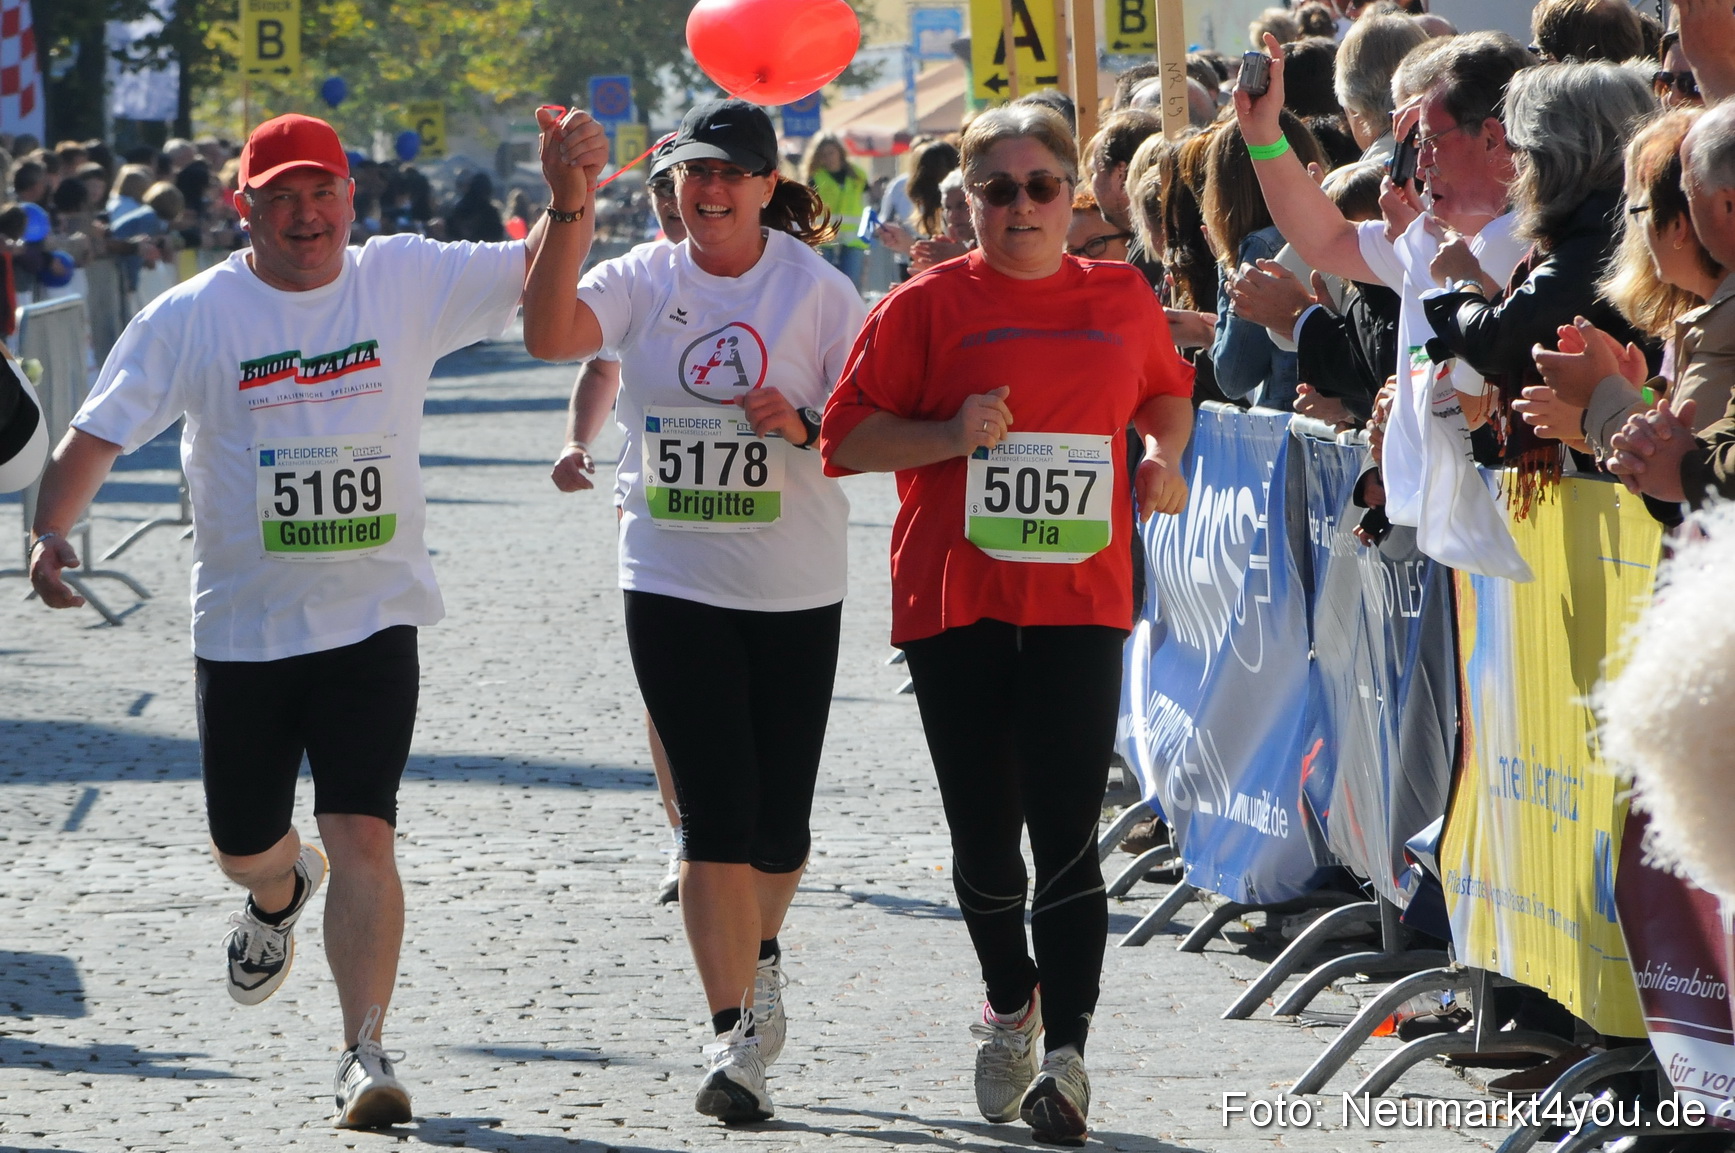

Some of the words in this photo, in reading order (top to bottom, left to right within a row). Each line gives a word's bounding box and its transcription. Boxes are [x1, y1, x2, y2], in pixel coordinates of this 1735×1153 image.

[993, 0, 1046, 64] A
[1120, 0, 1147, 34] B
[257, 19, 285, 60] B
[416, 117, 437, 146] C
[669, 314, 688, 326] erima
[276, 392, 324, 401] ITALIENISCHE
[331, 381, 383, 396] SPEZIALITÄTEN
[662, 417, 722, 429] PFLEIDERER
[277, 447, 338, 460] PFLEIDERER
[659, 439, 768, 487] 5178
[990, 444, 1053, 456] PFLEIDERER
[274, 466, 382, 517] 5169
[668, 488, 755, 520] Brigitte
[984, 466, 1097, 515] 5057
[972, 504, 978, 514] S
[280, 516, 380, 546] Gottfried
[1021, 519, 1060, 545] Pia
[1669, 1053, 1696, 1084] für
